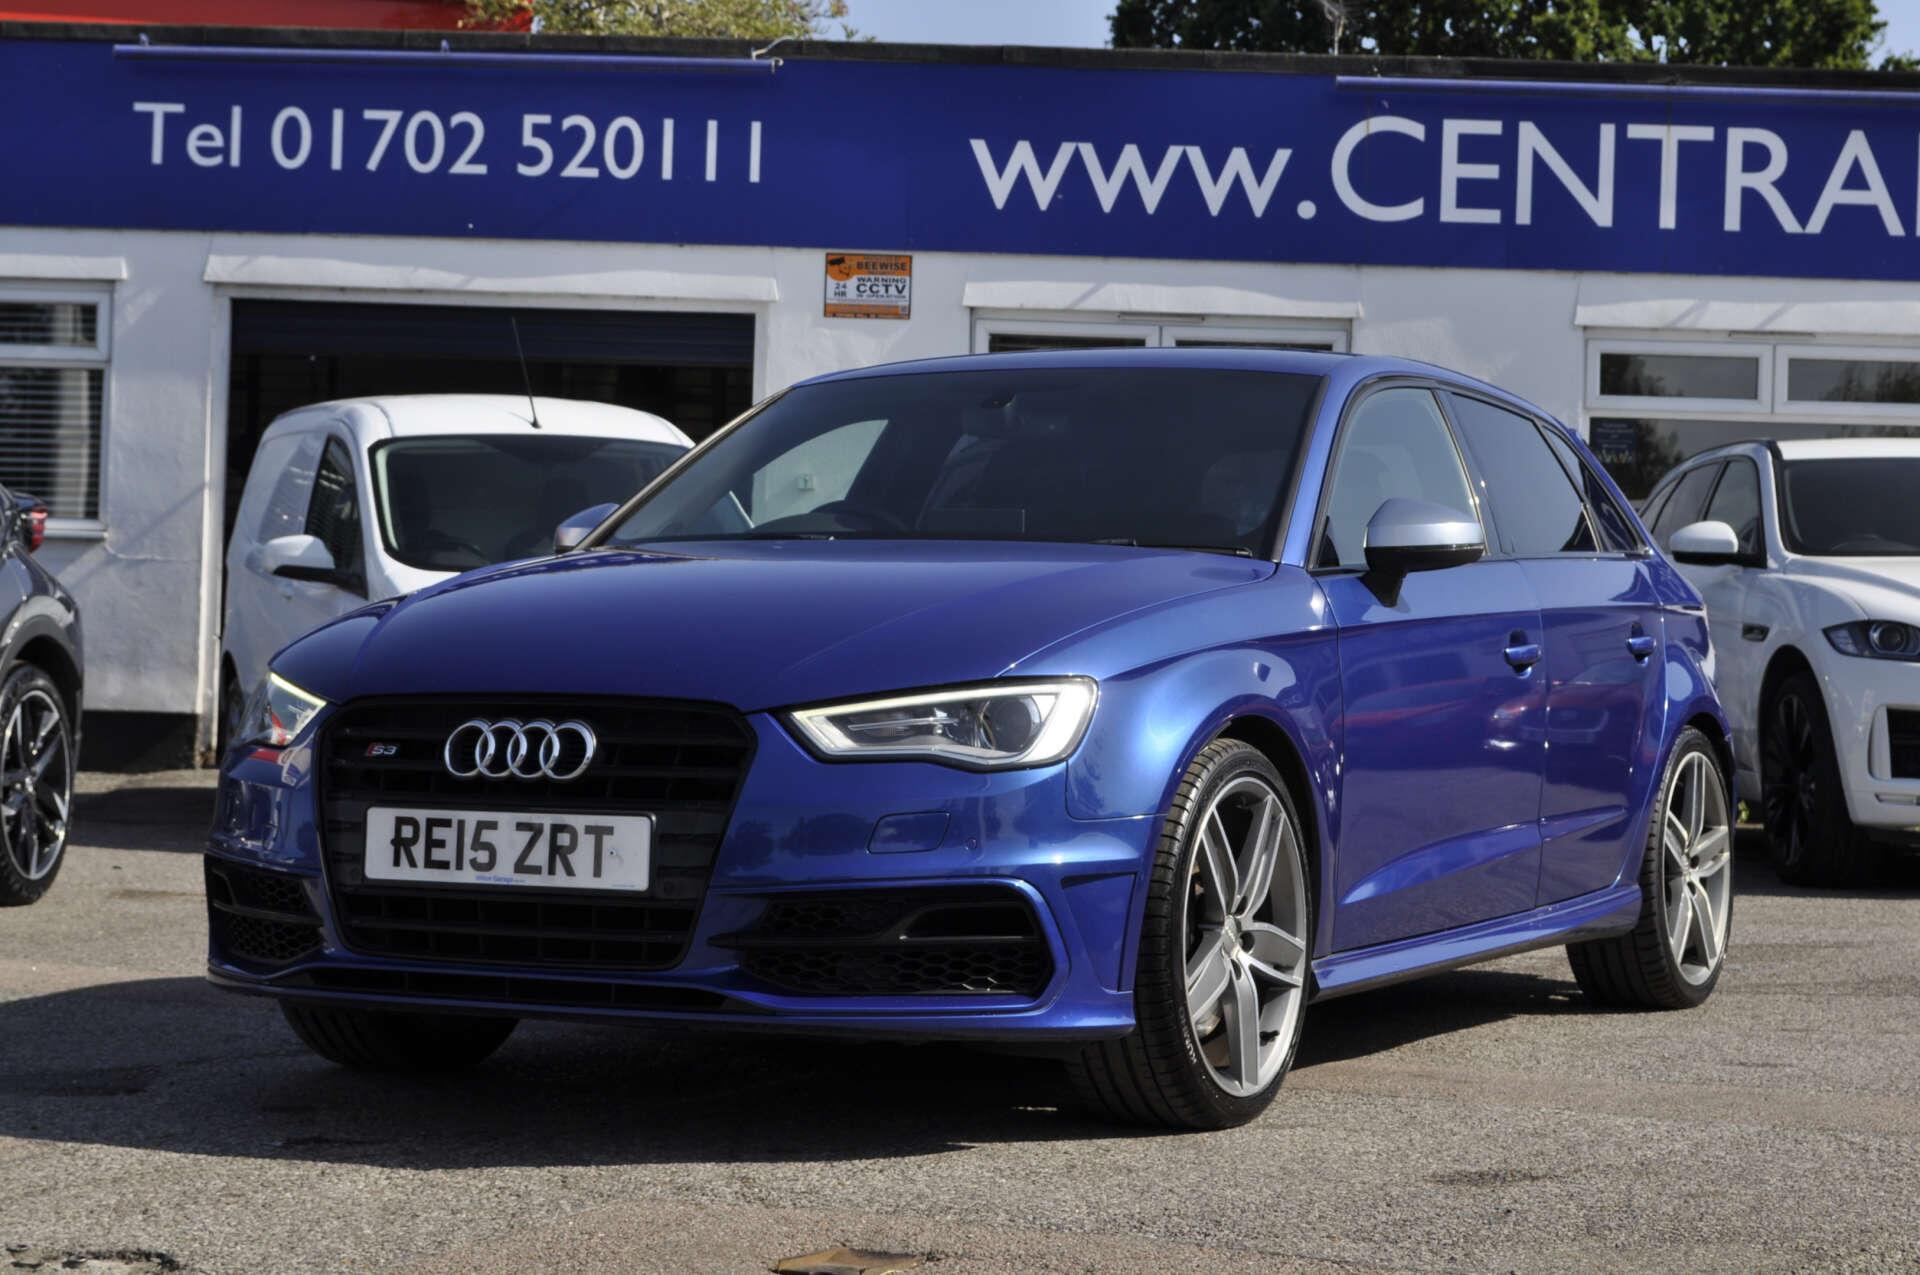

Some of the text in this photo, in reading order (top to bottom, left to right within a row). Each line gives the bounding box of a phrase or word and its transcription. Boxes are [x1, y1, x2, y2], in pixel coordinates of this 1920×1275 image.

[134, 103, 761, 183] Tel 01702 520111
[970, 116, 1920, 236] www.CENTRA
[856, 261, 907, 271] BEEWISE
[856, 276, 906, 284] WARNING
[834, 282, 847, 290] 24
[856, 284, 906, 294] CCTV
[371, 745, 397, 755] S3
[390, 816, 613, 877] RE15 ZRT
